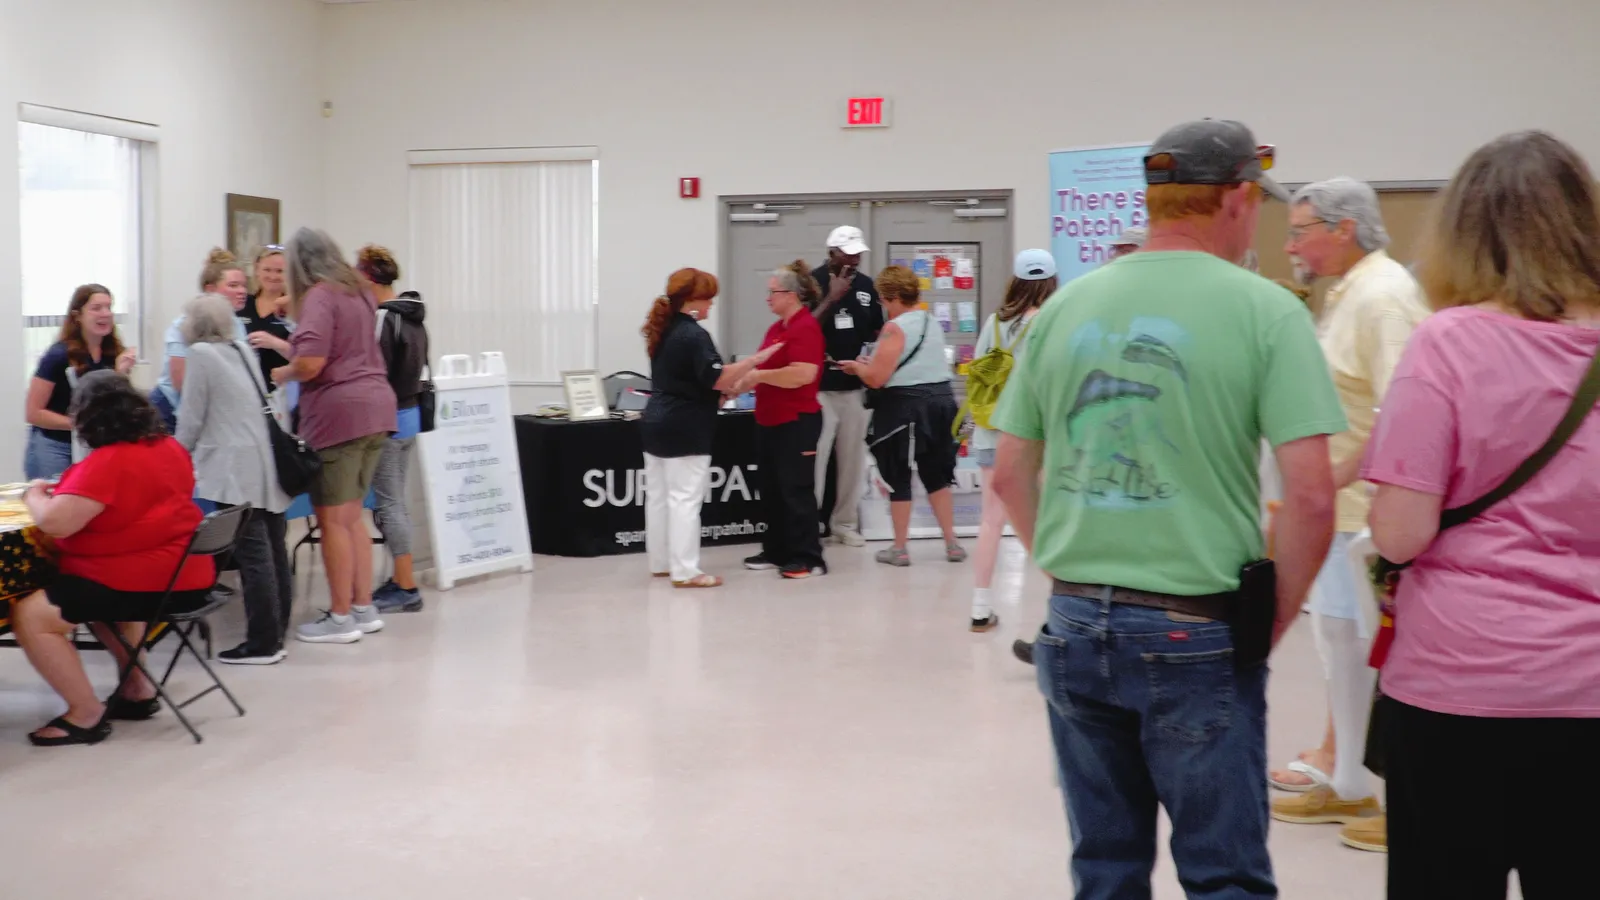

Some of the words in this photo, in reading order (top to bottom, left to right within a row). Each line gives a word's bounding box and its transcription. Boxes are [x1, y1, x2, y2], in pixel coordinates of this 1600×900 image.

[847, 98, 884, 125] EXIT
[1052, 212, 1124, 238] Patch
[451, 399, 491, 419] Bloom
